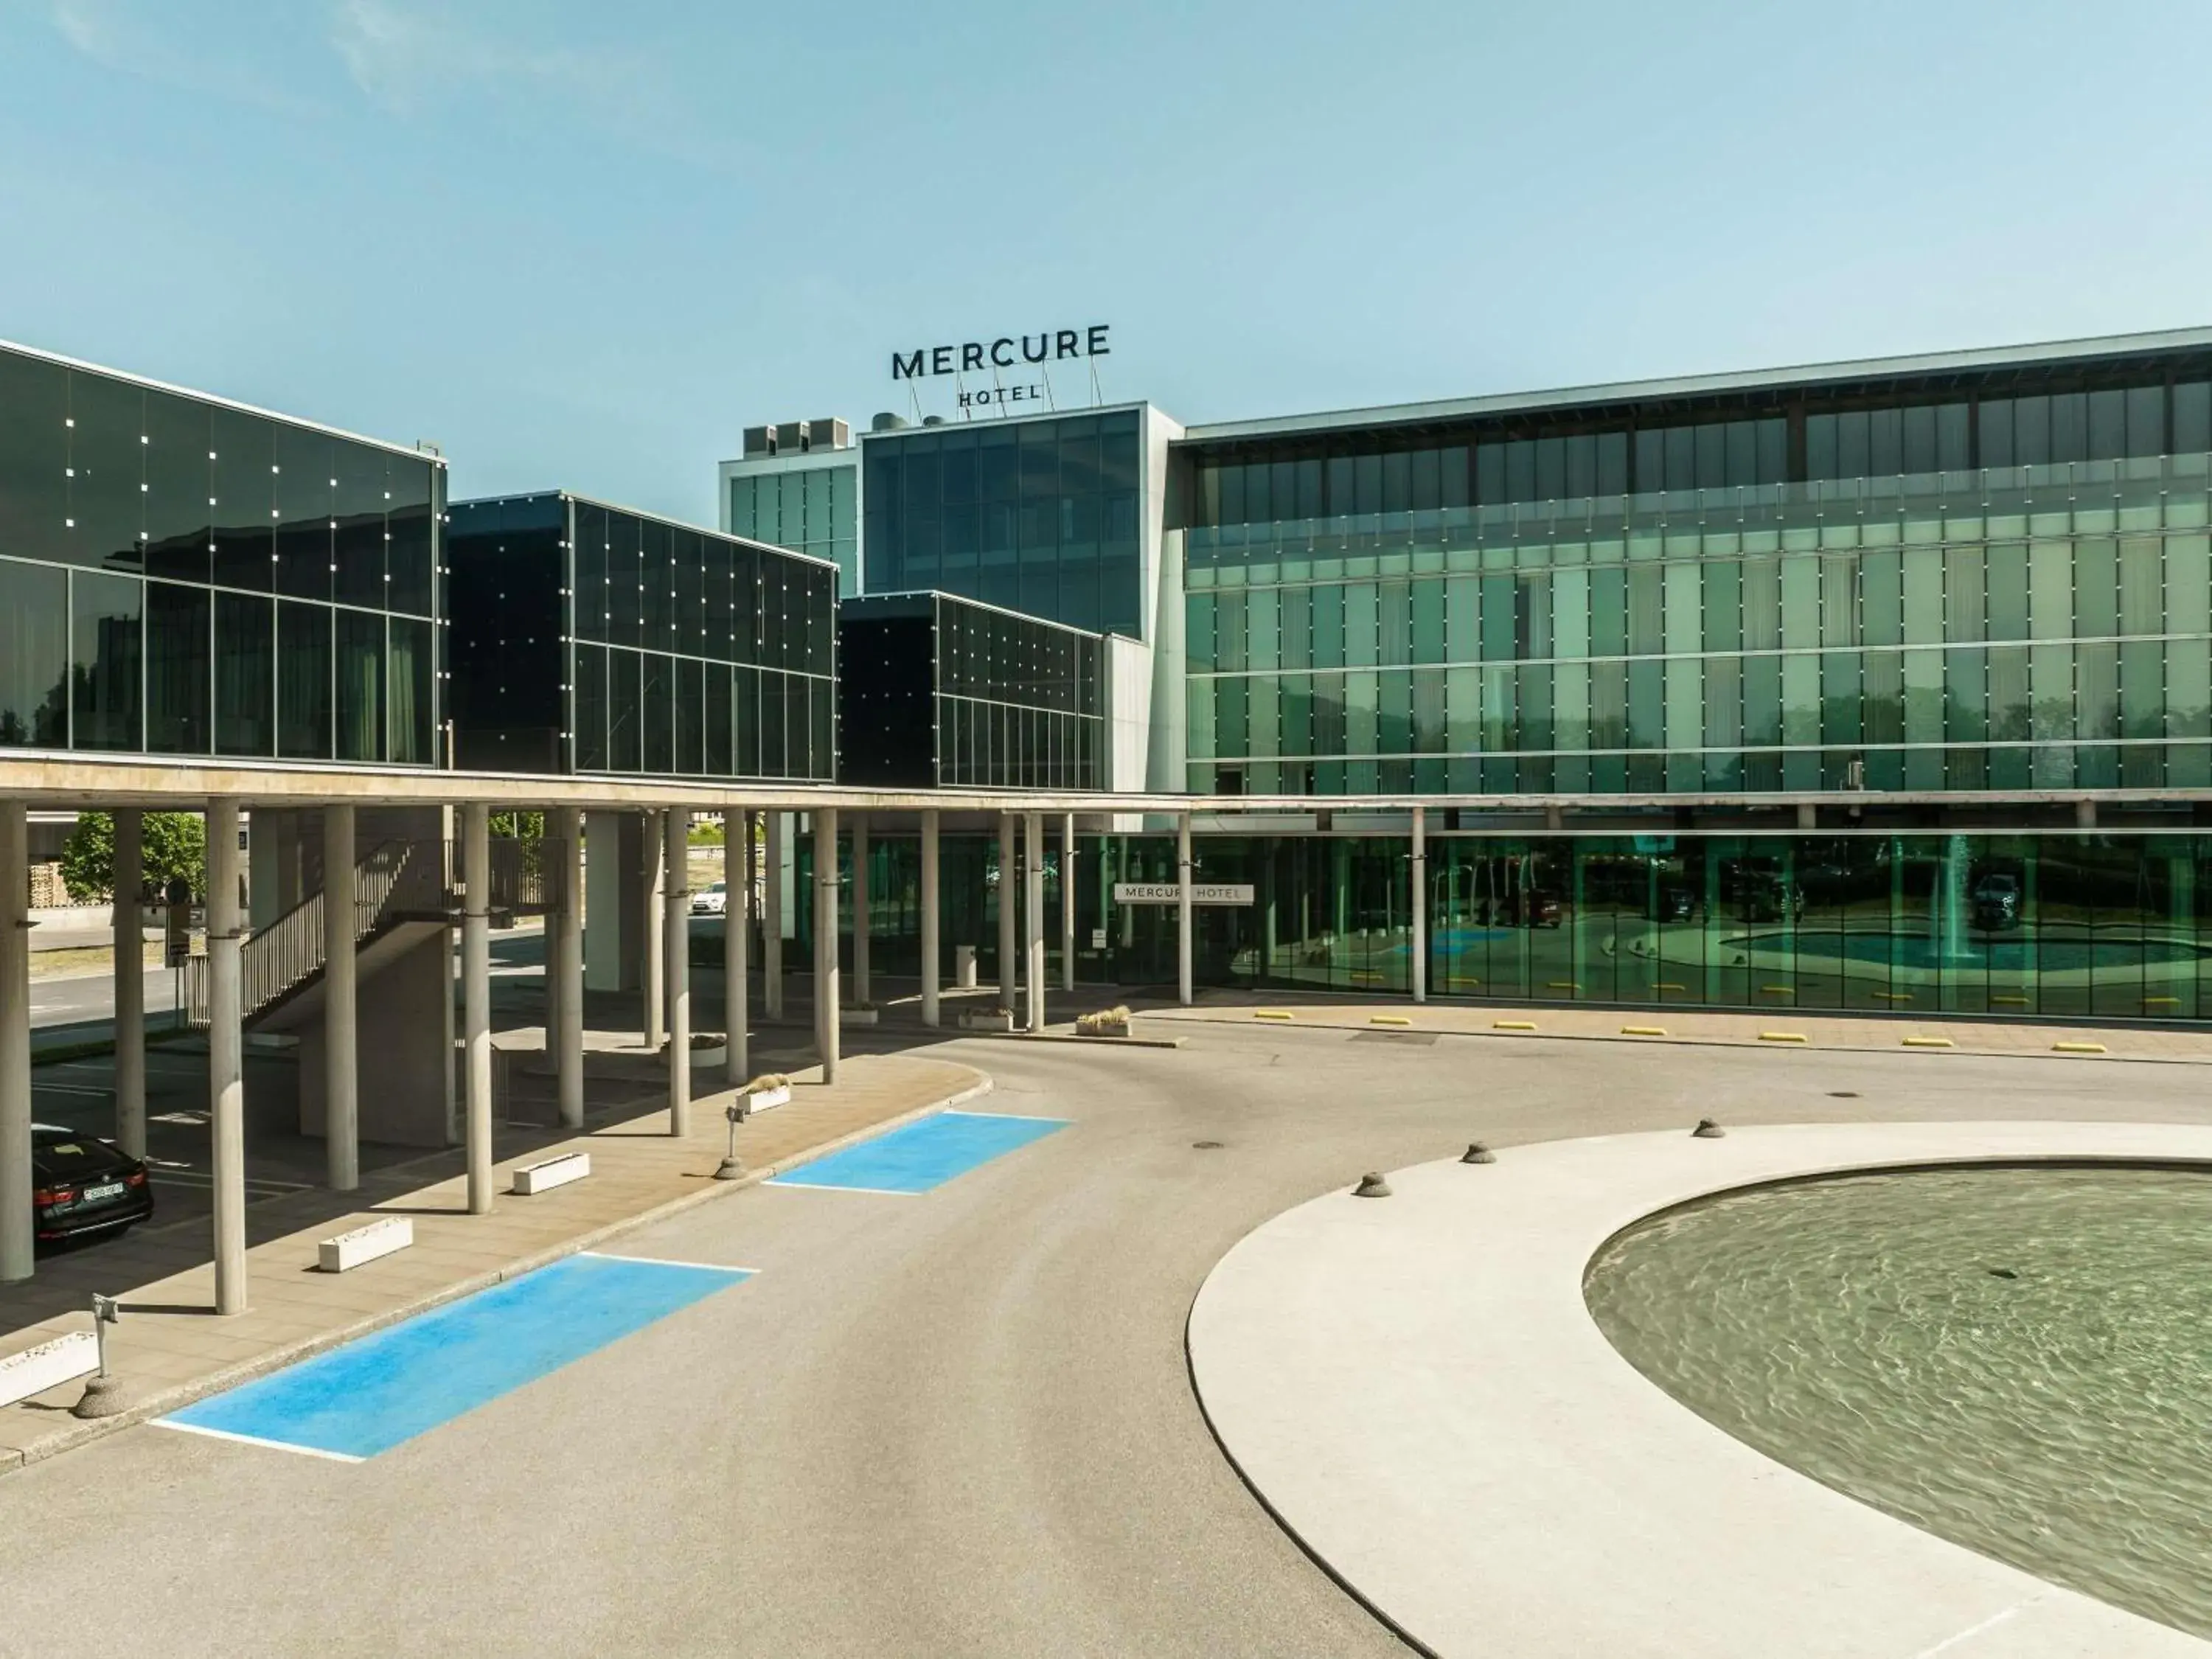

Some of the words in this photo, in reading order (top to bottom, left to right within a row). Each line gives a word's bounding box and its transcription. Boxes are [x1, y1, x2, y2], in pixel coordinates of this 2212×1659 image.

[892, 324, 1110, 380] MERCURE
[959, 384, 1041, 407] HOTEL
[1125, 887, 1180, 897] MERCUR
[1197, 888, 1242, 899] HOTEL
